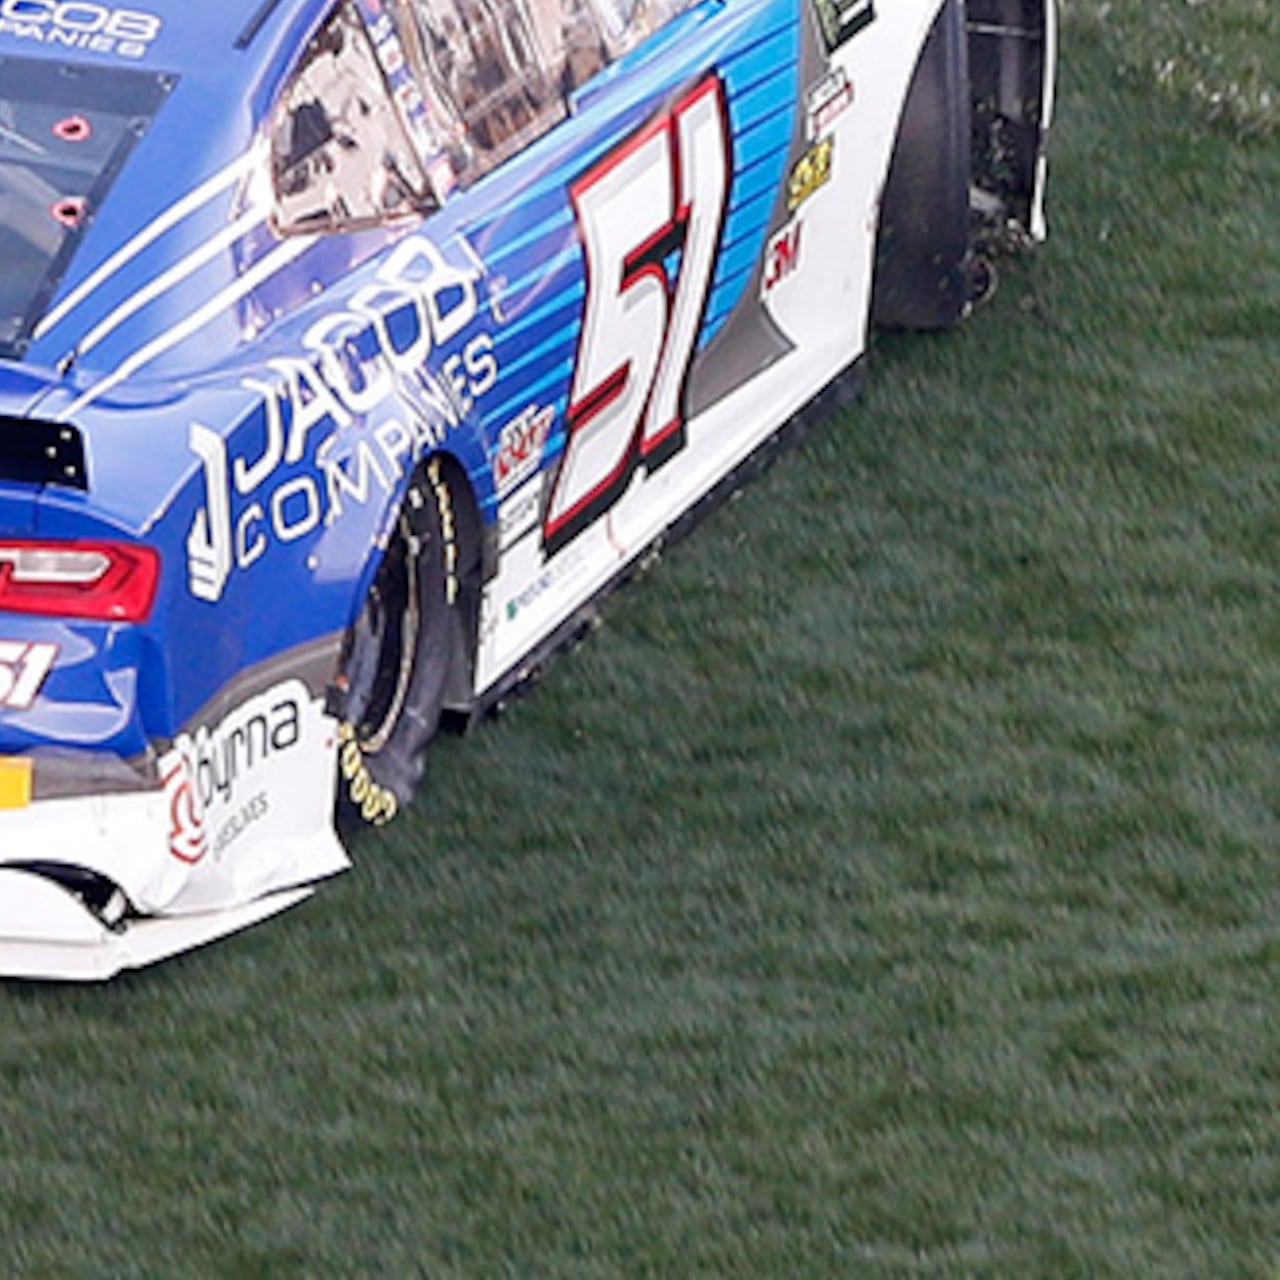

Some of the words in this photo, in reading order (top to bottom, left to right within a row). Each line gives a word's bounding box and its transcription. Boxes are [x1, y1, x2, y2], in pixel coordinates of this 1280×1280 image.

[233, 234, 480, 495] JACOB
[544, 64, 733, 561] 51
[239, 333, 498, 570] COMPANIES
[197, 699, 299, 809] byrna
